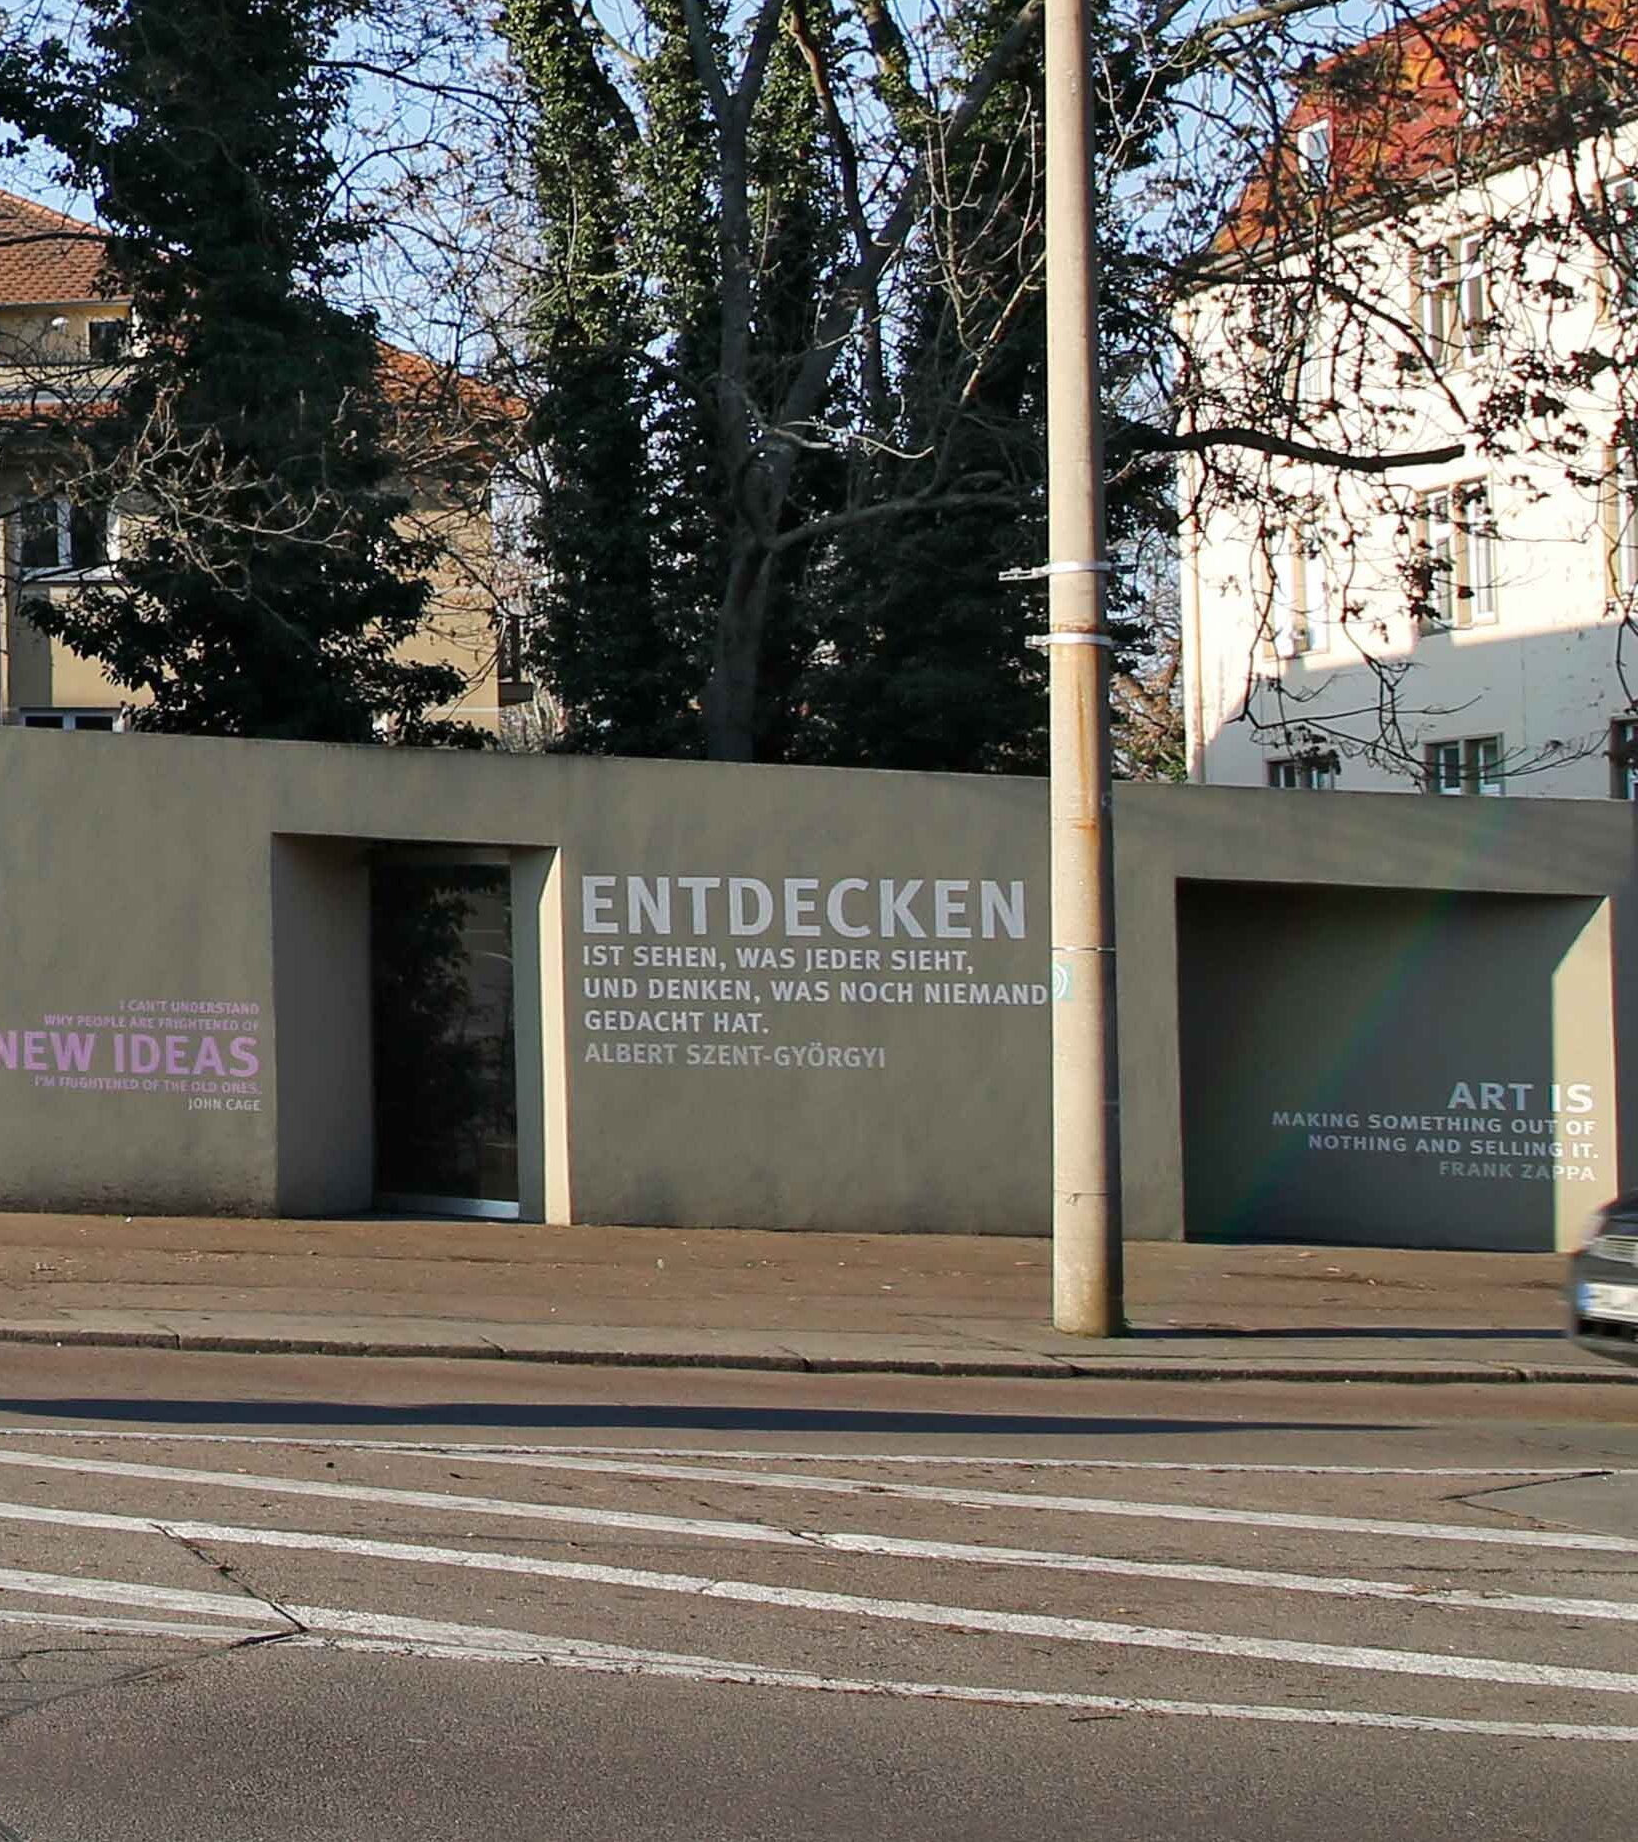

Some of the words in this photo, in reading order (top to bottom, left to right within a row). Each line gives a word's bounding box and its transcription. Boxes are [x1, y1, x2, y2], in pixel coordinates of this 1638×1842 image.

[581, 875, 1026, 939] ENTDECKEN
[583, 946, 624, 968] IST
[633, 946, 727, 972] SEHEN,
[737, 948, 796, 970] WAS
[804, 949, 882, 974] JEDER
[891, 950, 974, 975] SIEHT,
[584, 978, 639, 1000] UND
[648, 979, 762, 1005] DENKEN,
[771, 981, 830, 1003] WAS
[840, 981, 914, 1004] NOCH
[924, 983, 1048, 1006] NIEMAND
[171, 1000, 261, 1015] UNDERSTAND
[44, 1014, 73, 1027] WHY
[77, 1015, 127, 1028] PEOPLE
[129, 1017, 155, 1029] ARE
[158, 1018, 239, 1031] FRIGHTENED
[242, 1020, 260, 1031] OF
[584, 1011, 703, 1034] GEDACHT
[713, 1013, 770, 1035] HAT.
[113, 1033, 261, 1077] IDEAS
[584, 1043, 677, 1065] ALBERT
[686, 1042, 885, 1069] SZENT-GYÖRGYI
[59, 1076, 139, 1091] FRIGHTENED
[142, 1079, 160, 1091] OF
[163, 1080, 189, 1092] THE
[190, 1080, 217, 1093] OLD
[187, 1098, 223, 1111] JOHN
[225, 1099, 262, 1112] CAGE
[1447, 1081, 1534, 1112] ART
[1552, 1083, 1594, 1114] IS
[1272, 1111, 1360, 1129] MAKING
[1368, 1114, 1502, 1134] SOMETHING
[1511, 1119, 1559, 1136] OUT
[1565, 1120, 1597, 1136] OF
[1308, 1134, 1407, 1153] NOTHING
[1415, 1139, 1462, 1155] AND
[1470, 1140, 1563, 1158] SELLING
[1572, 1142, 1599, 1159] IT.
[1439, 1161, 1513, 1179] FRANK
[1520, 1164, 1597, 1182] ZAPPA
